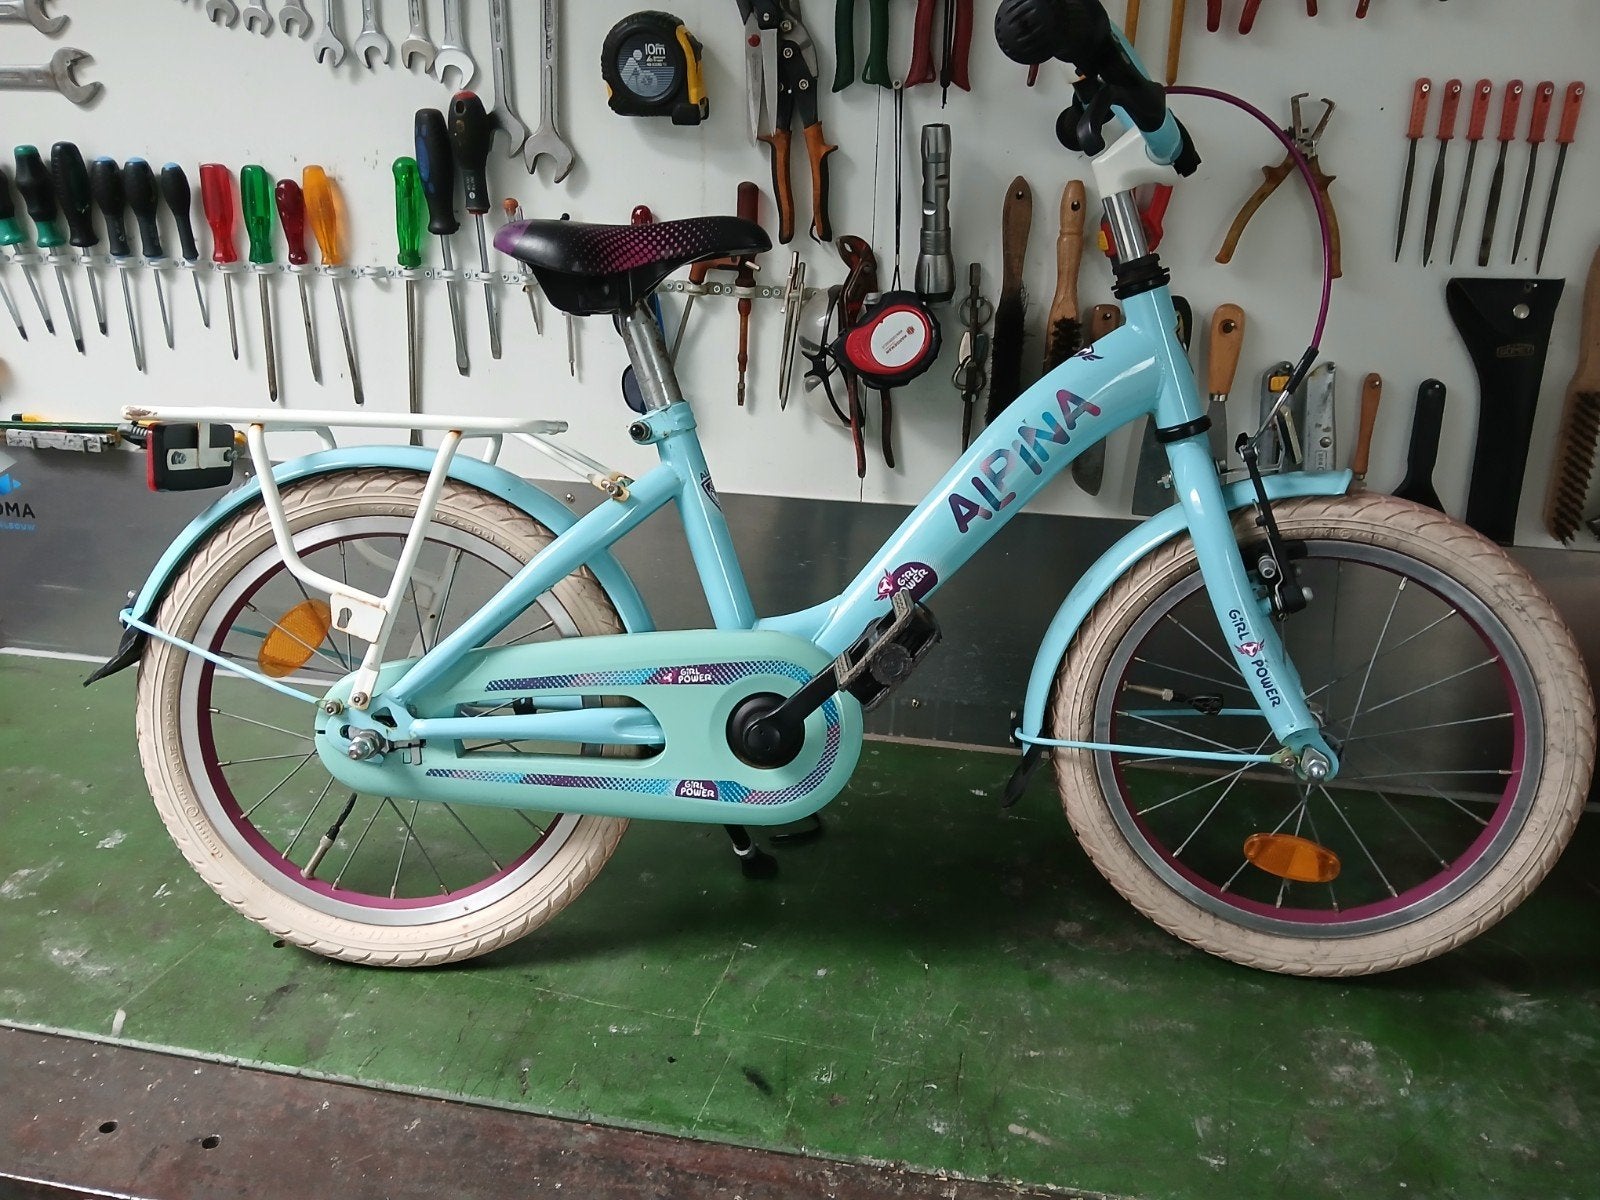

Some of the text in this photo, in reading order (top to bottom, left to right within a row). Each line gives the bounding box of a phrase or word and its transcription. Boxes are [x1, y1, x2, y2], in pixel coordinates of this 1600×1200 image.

[645, 43, 665, 55] 10m
[948, 389, 1101, 534] ALPINA
[0, 501, 36, 519] MA
[900, 568, 929, 590] WER
[678, 673, 712, 684] POWER
[1251, 659, 1281, 708] POWER
[680, 787, 715, 798] POWER
